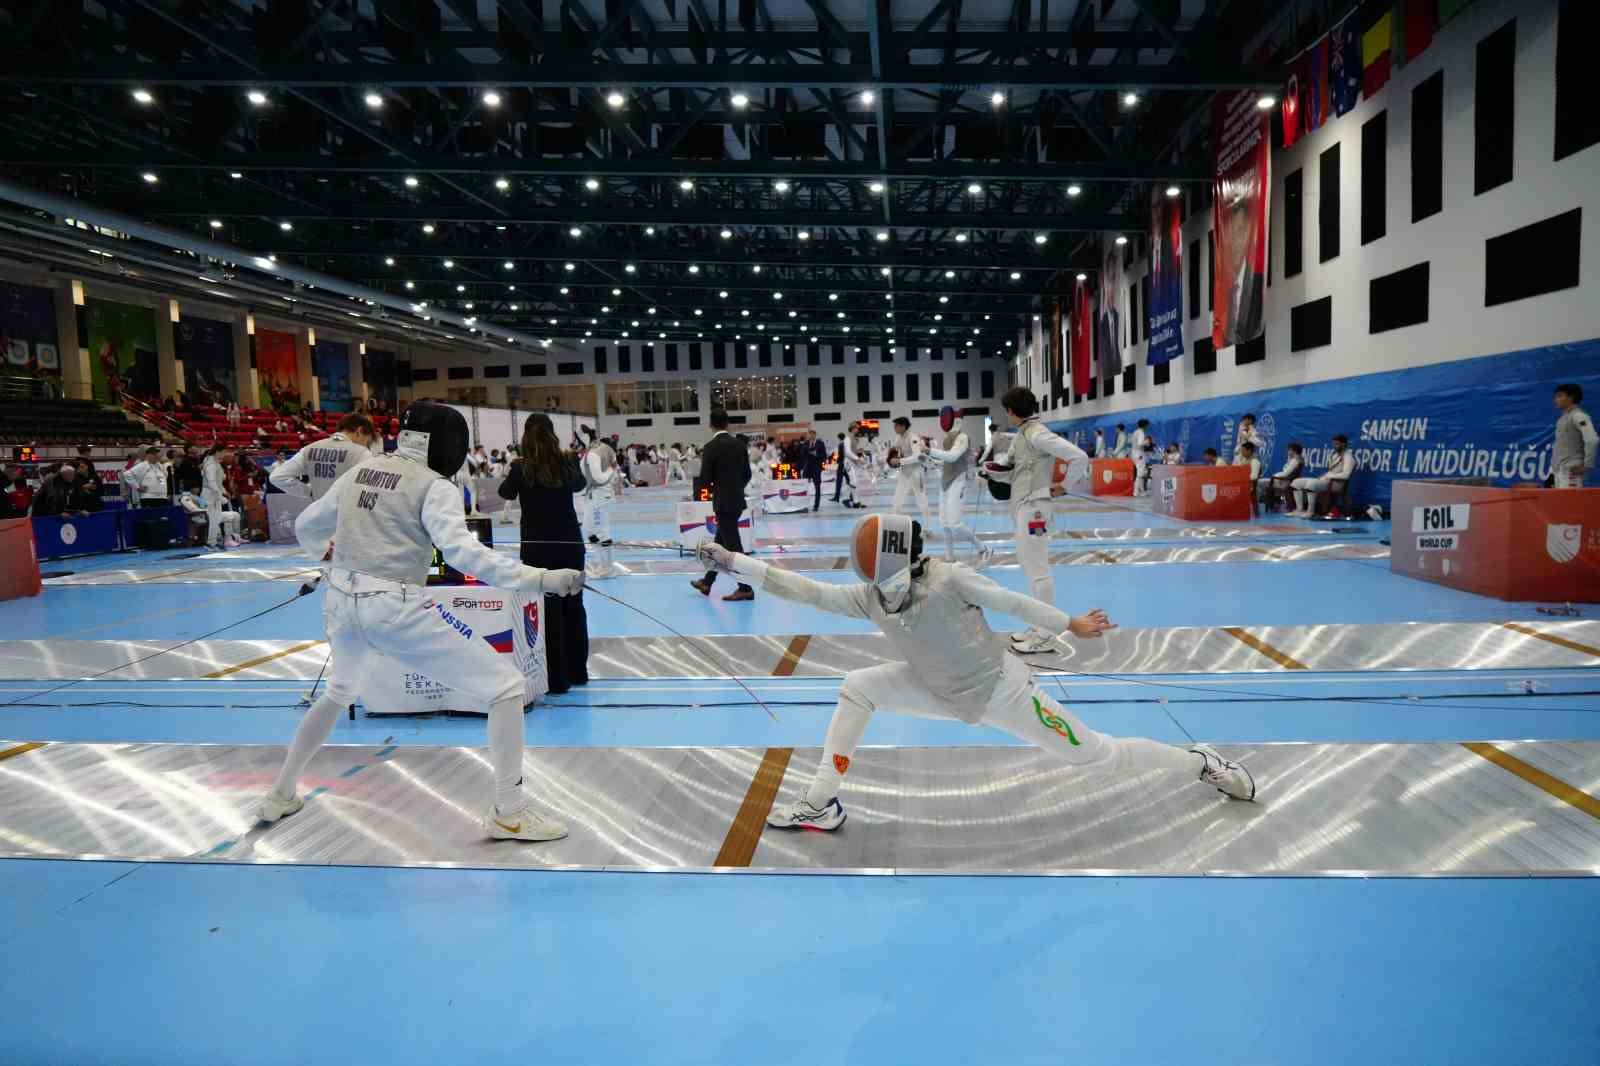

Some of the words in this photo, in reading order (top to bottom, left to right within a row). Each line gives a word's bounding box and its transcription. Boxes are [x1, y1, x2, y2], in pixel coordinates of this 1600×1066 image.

[1360, 417, 1428, 441] SAMSUN
[314, 463, 336, 478] RUS
[1354, 448, 1391, 471] SPOR
[1397, 445, 1410, 472] İL
[1414, 442, 1553, 480] MÜDÜRLÜĞÜ
[357, 490, 378, 511] RUS
[1423, 506, 1454, 530] FOIL
[881, 530, 908, 554] IRL
[1419, 538, 1440, 548] WORLD
[1440, 537, 1453, 549] CUP
